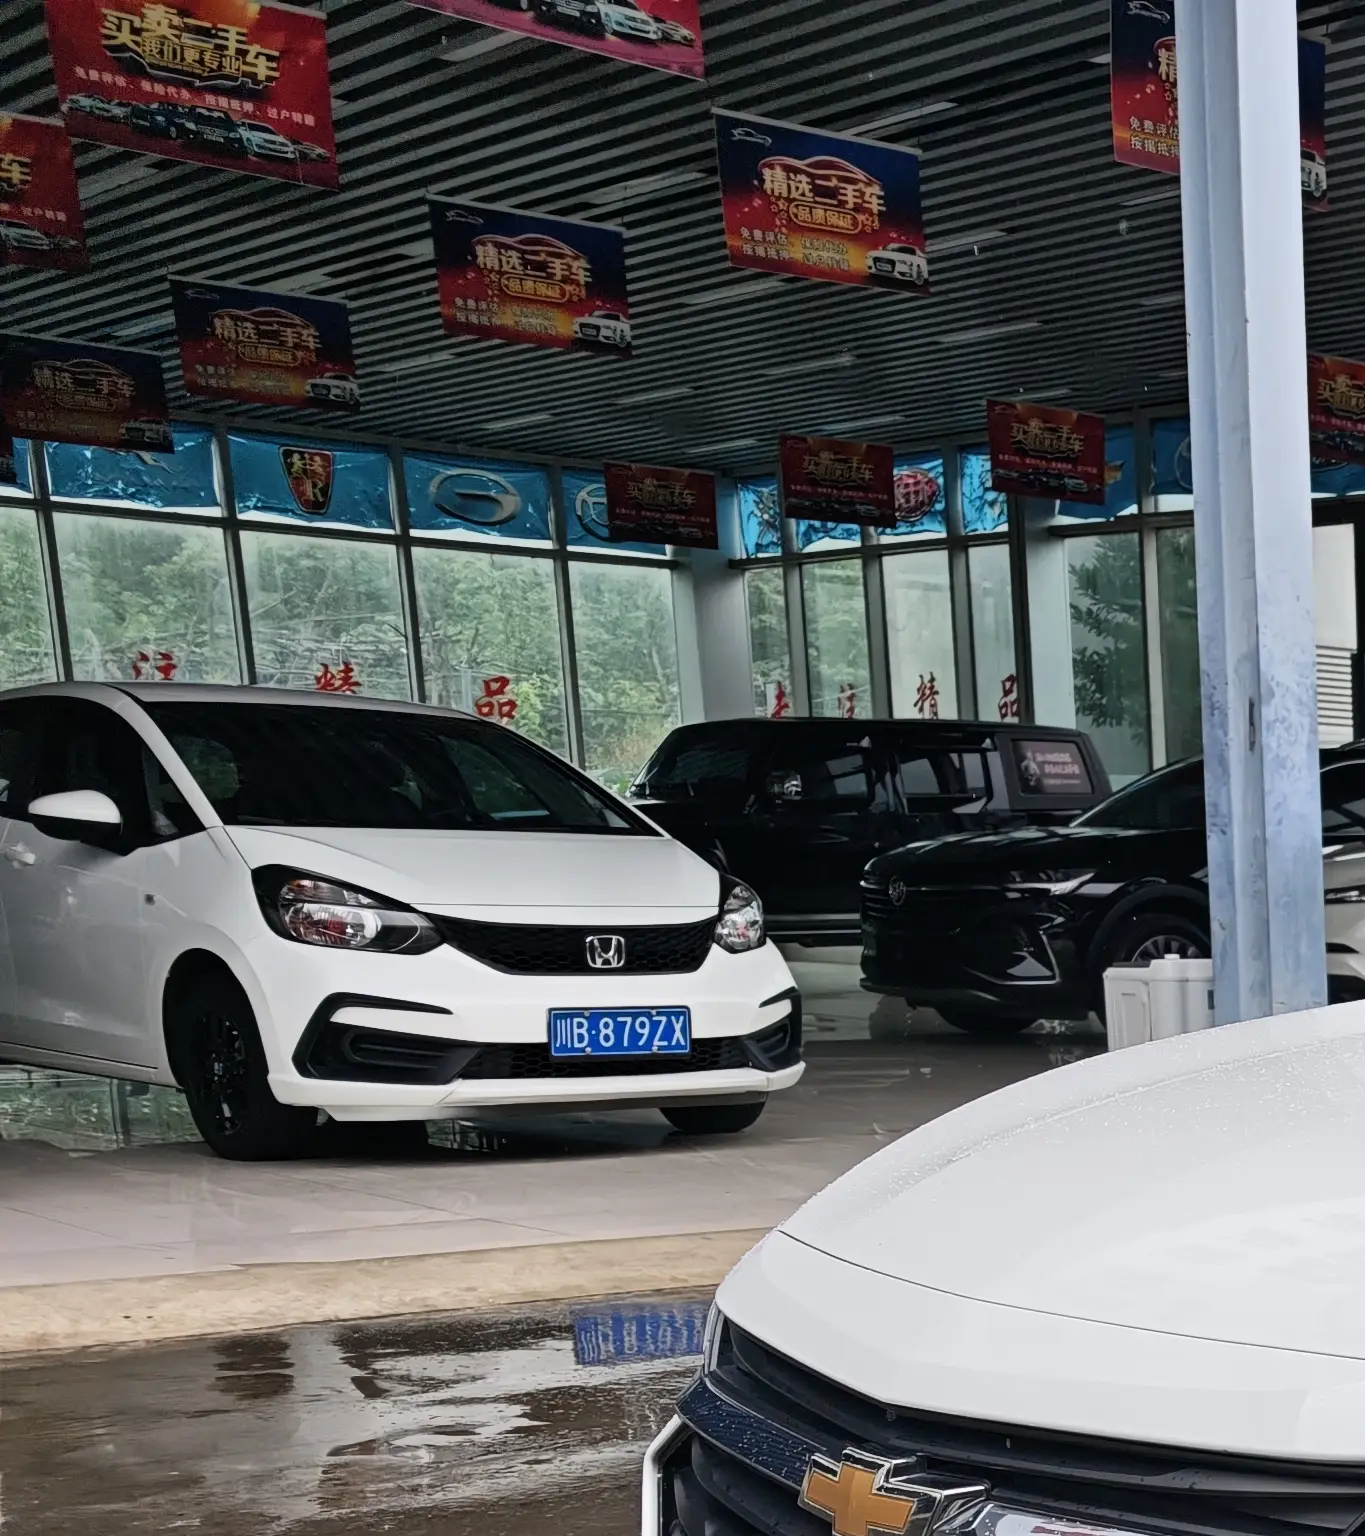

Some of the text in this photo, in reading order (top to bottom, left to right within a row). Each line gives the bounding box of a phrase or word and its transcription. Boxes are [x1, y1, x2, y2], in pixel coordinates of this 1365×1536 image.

[100, 3, 280, 82] 买卖二手车
[762, 163, 886, 214] 精选二手车
[475, 242, 592, 285] 精选二手车
[213, 315, 323, 351] 精选二手车
